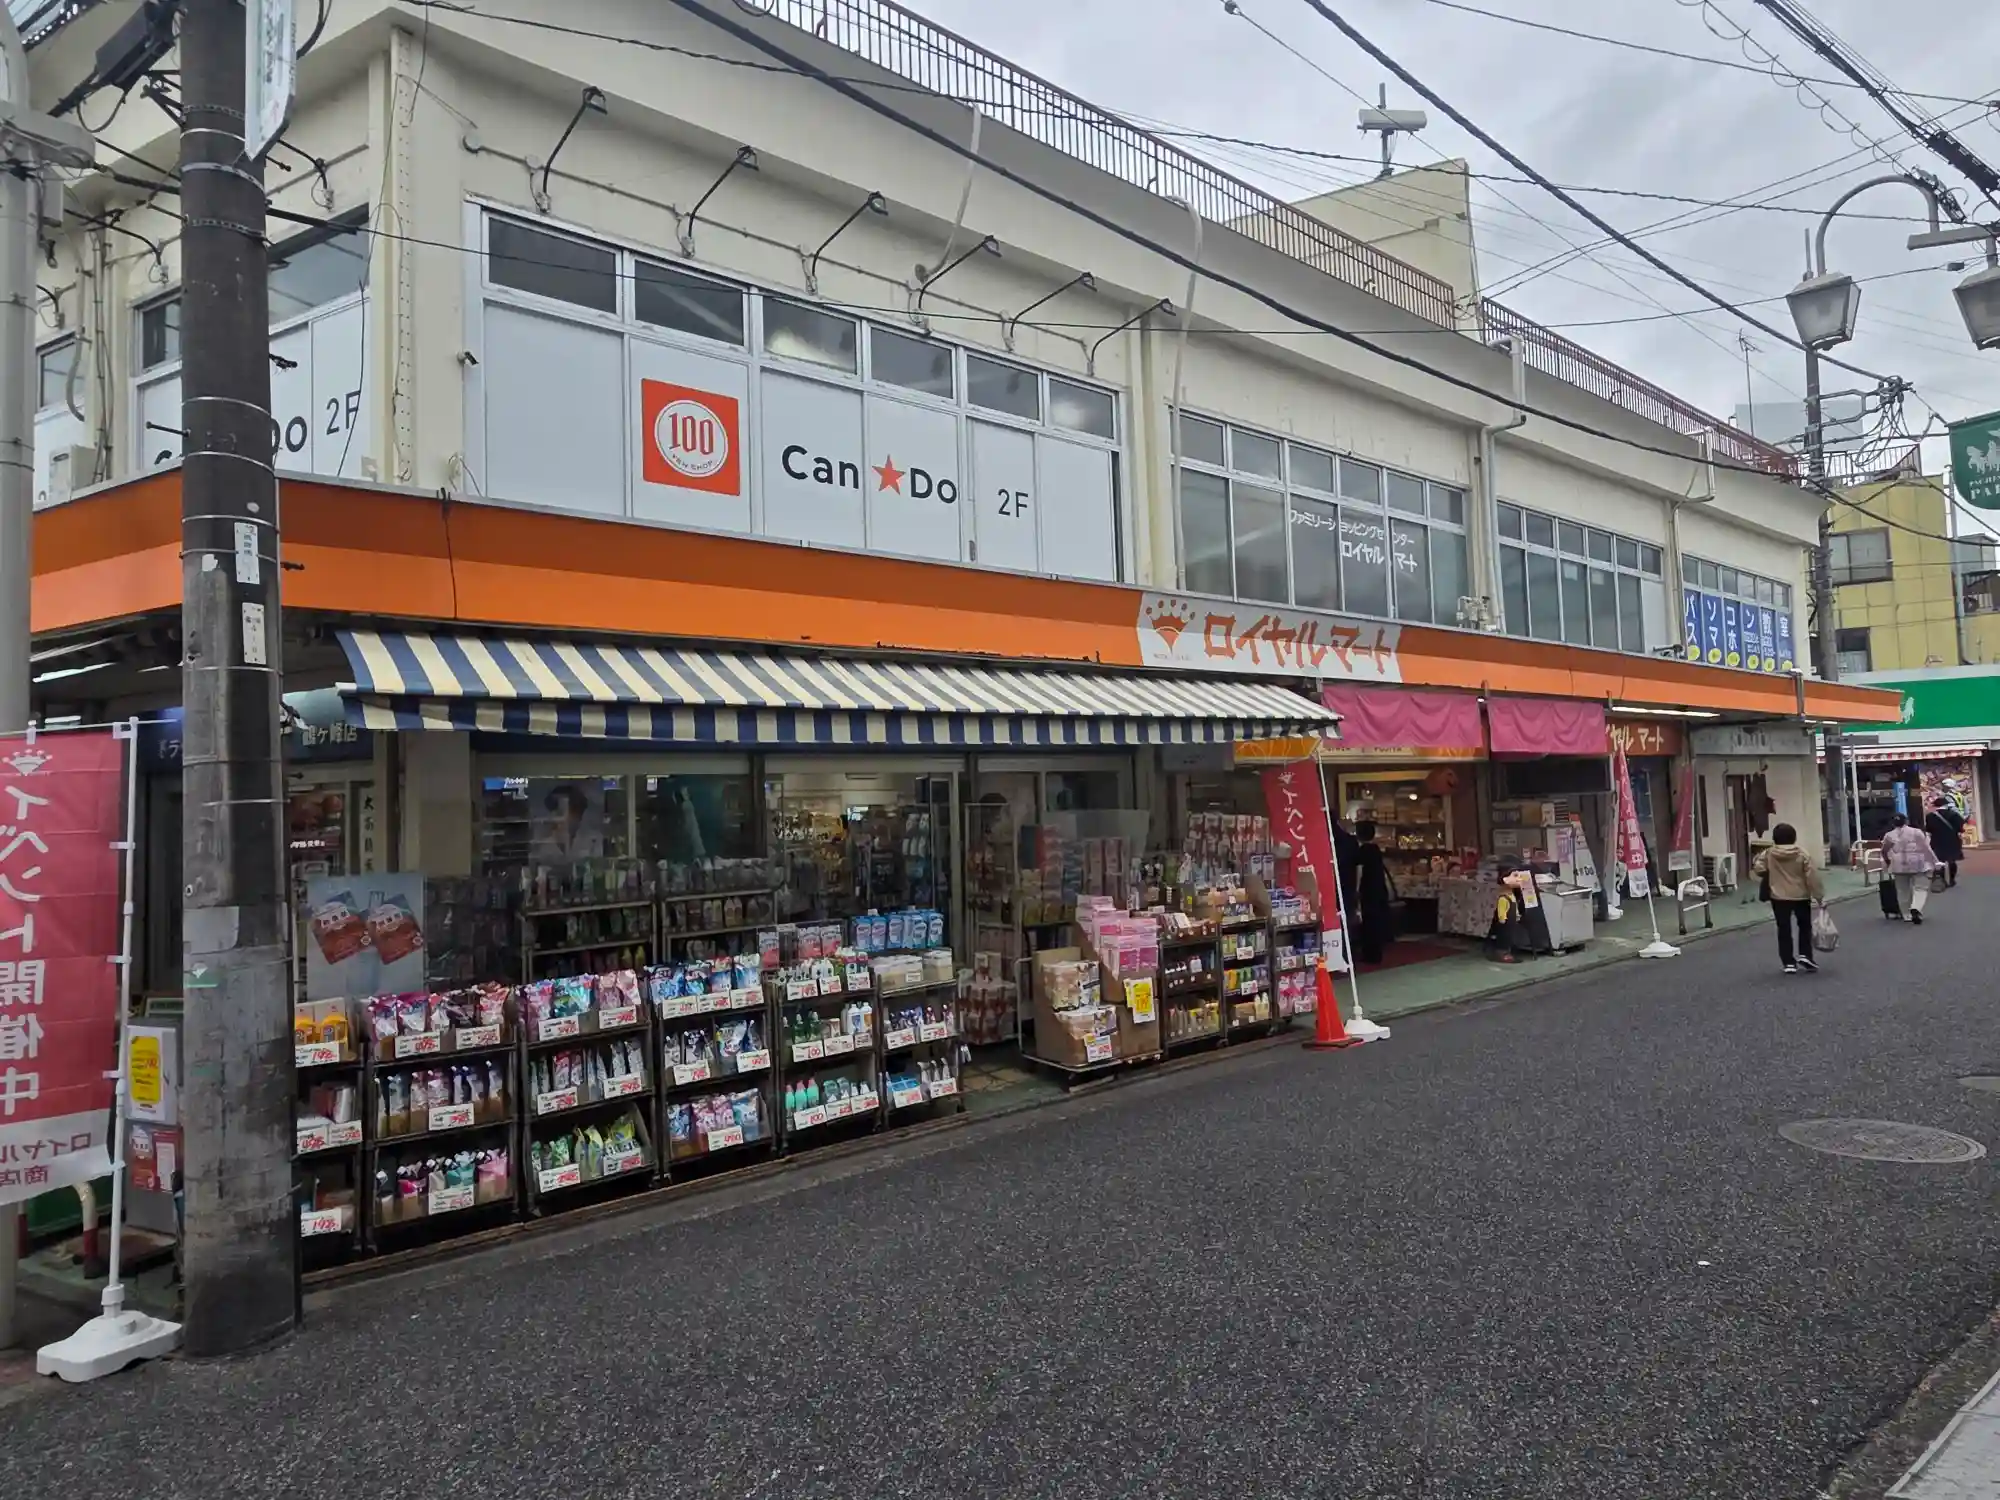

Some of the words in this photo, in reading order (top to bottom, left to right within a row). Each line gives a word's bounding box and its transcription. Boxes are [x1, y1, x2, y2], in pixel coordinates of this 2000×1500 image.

[325, 390, 361, 435] 2F
[668, 412, 714, 456] 100
[781, 445, 860, 490] Can
[910, 468, 958, 505] Do
[997, 489, 1029, 518] 2F
[1204, 611, 1392, 675] ロイヤルマート
